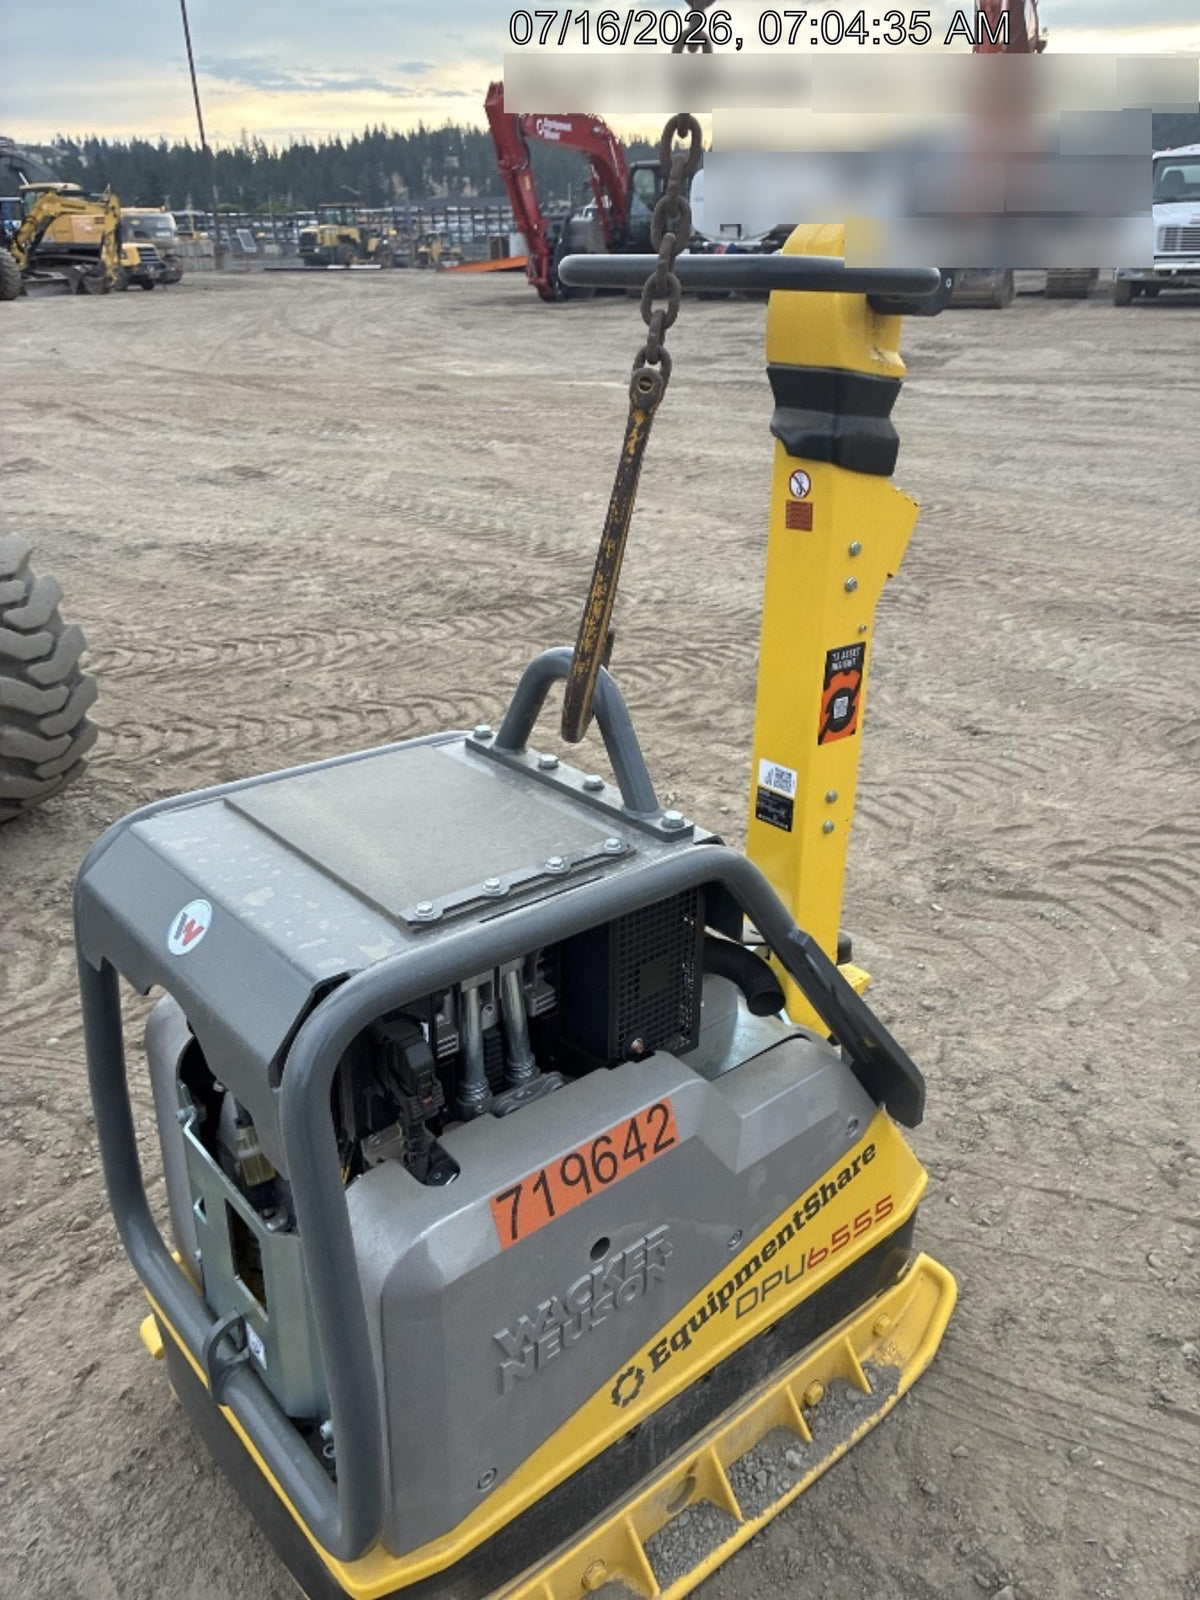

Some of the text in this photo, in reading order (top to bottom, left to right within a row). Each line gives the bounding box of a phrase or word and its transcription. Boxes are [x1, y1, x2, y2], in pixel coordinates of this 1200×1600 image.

[496, 1103, 675, 1240] 719642
[493, 1224, 675, 1359] WACKER
[648, 1143, 876, 1373] EquipmentShare
[735, 1195, 893, 1320] DPU6555
[499, 1262, 667, 1394] NEUSON
